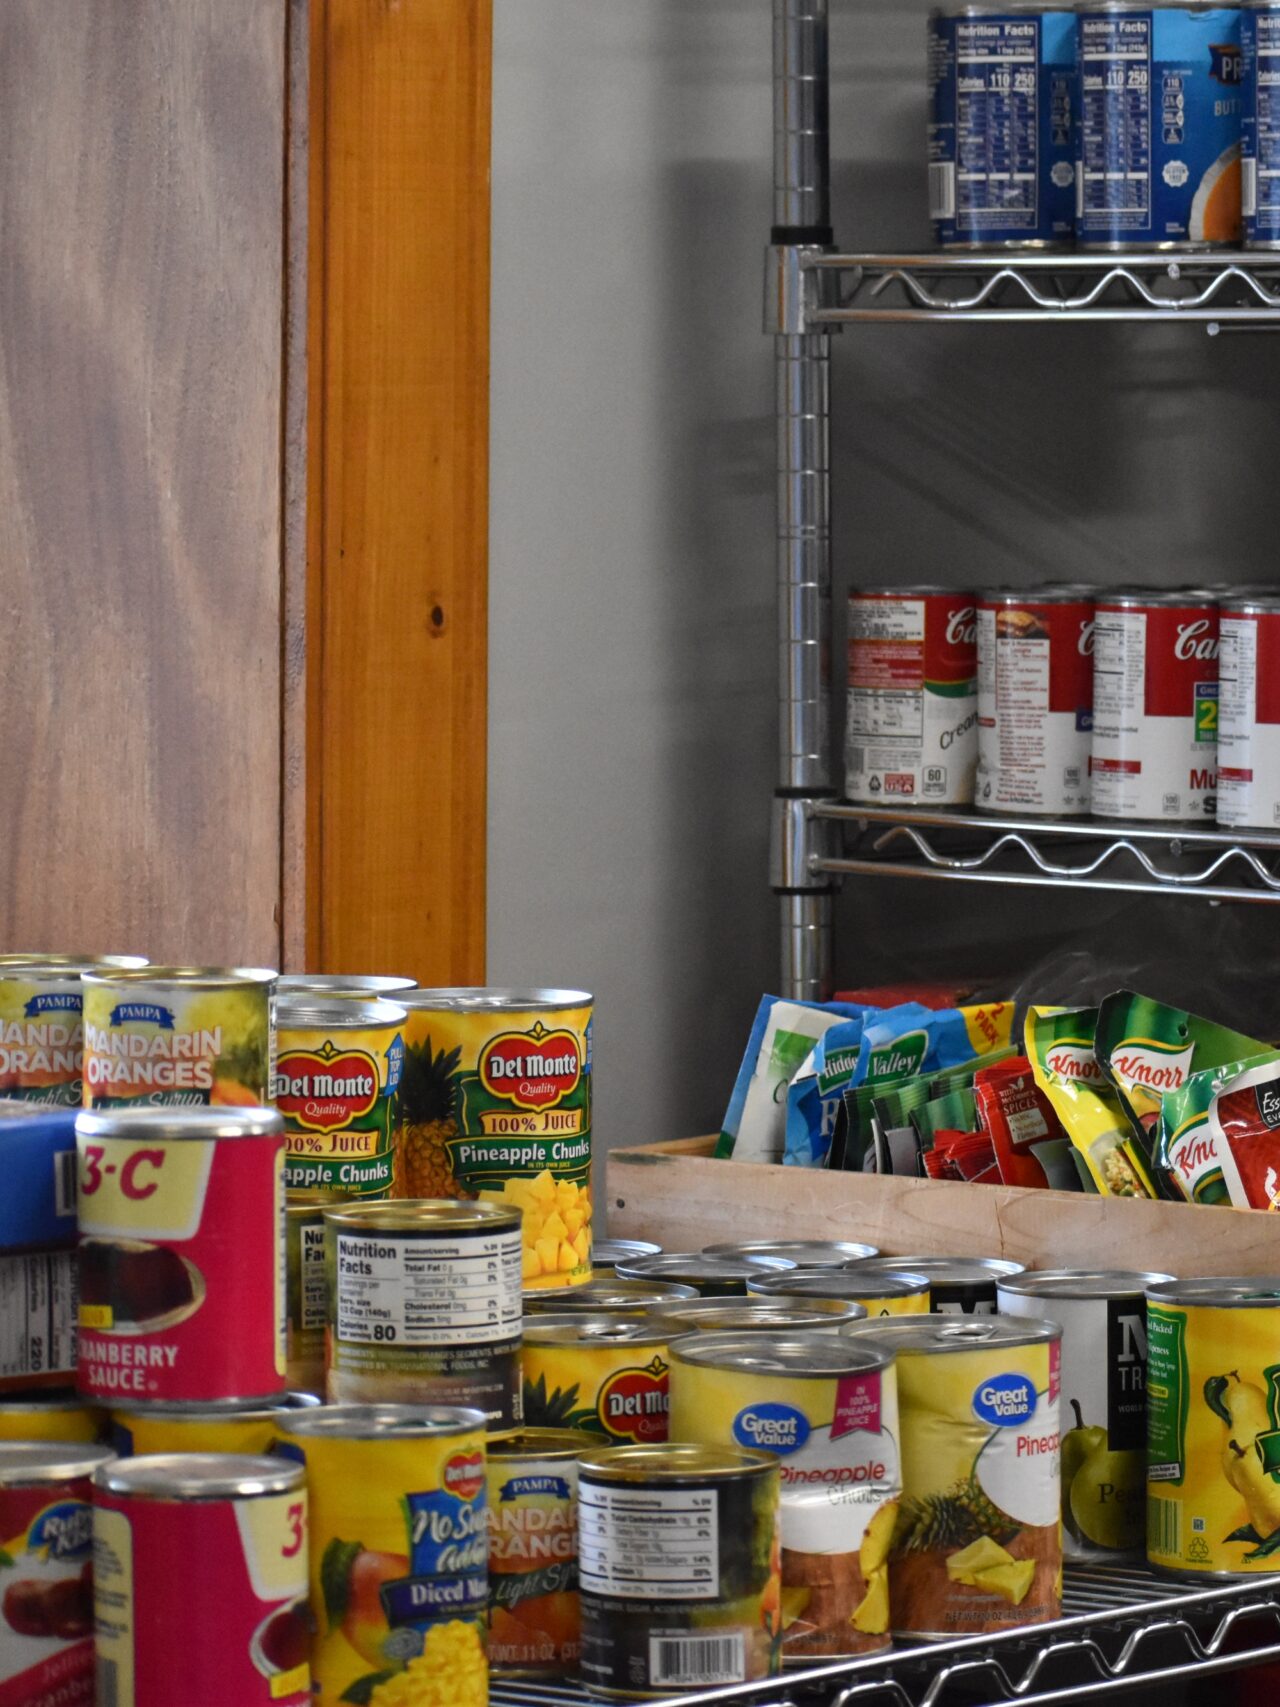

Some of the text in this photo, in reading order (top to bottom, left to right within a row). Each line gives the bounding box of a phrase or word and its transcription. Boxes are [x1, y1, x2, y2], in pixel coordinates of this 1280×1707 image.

[1004, 24, 1034, 36] Facts
[1119, 22, 1147, 33] Facts
[990, 74, 1010, 86] 110
[1014, 73, 1035, 86] 250
[1107, 71, 1147, 85] 110 250
[1199, 702, 1217, 730] 2
[928, 769, 941, 782] 60
[37, 996, 83, 1011] PAMPA
[119, 1006, 161, 1021] PAMPA
[974, 1008, 1001, 1047] PACK
[86, 1019, 222, 1058] MANDARIN
[87, 1056, 214, 1089] ORANGES
[490, 1054, 577, 1078] Del Monte
[871, 1051, 917, 1077] Valley
[1113, 1055, 1184, 1089] Knorr
[277, 1074, 373, 1097] Del Monte
[519, 1081, 557, 1097] Quality
[304, 1101, 347, 1118] Quality
[1003, 1096, 1039, 1117] SPICES
[491, 1112, 577, 1133] 100% JUICE
[328, 1133, 371, 1153] JUICE
[459, 1138, 590, 1167] Pineapple Chunks
[81, 1144, 166, 1201] 3-C
[339, 1162, 389, 1183] Chunks
[339, 1240, 397, 1260] Nutrition
[339, 1257, 373, 1276] Facts
[404, 1263, 440, 1272] Total Fat
[404, 1302, 451, 1311] Cholesterol
[404, 1315, 436, 1323] Sodium
[1153, 1322, 1173, 1335] Packed
[374, 1324, 397, 1342] 80
[31, 1336, 43, 1372] 220
[88, 1364, 146, 1391] SAUCE
[856, 1385, 866, 1395] IN
[980, 1385, 1029, 1406] Great
[610, 1392, 643, 1416] Del
[837, 1403, 880, 1418] PINEAPPLE
[849, 1395, 870, 1406] 100%
[994, 1402, 1029, 1417] Value
[741, 1413, 797, 1435] Great
[845, 1415, 870, 1426] JUICE
[753, 1430, 797, 1446] Value
[512, 1478, 559, 1494] PAMPA
[411, 1510, 451, 1544] No
[411, 1579, 465, 1606] Diced
[496, 1574, 539, 1610] Light
